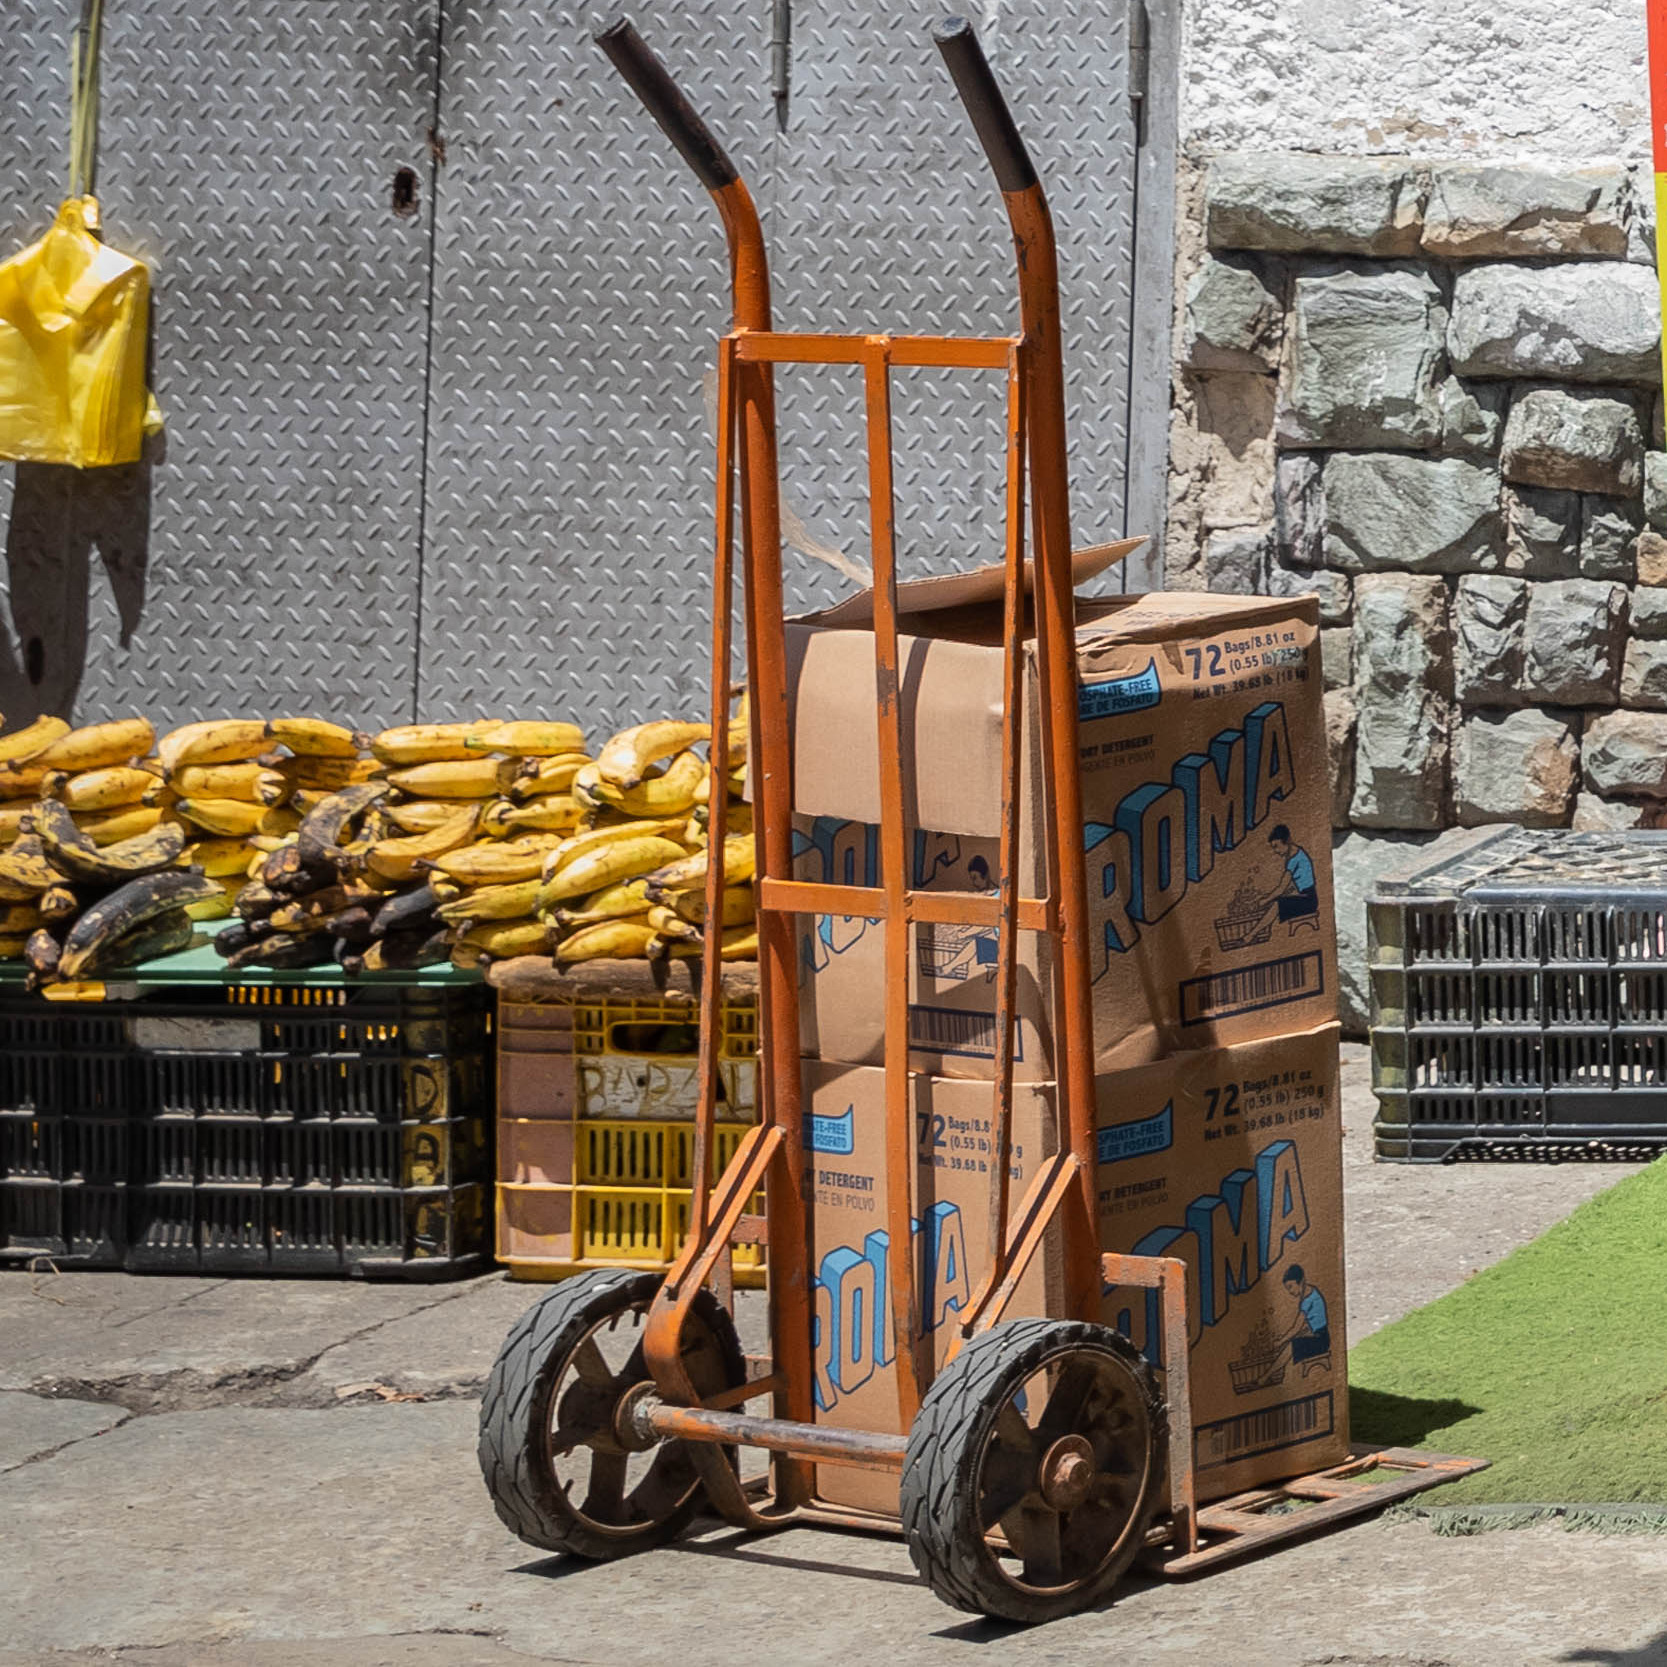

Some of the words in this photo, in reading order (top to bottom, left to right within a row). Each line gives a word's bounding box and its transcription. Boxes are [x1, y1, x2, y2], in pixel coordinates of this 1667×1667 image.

[1185, 644, 1225, 680] 72
[1224, 632, 1279, 654] Bags/8.81
[1283, 632, 1295, 643] oz
[1230, 658, 1259, 675] (0.55
[1204, 1083, 1240, 1121] 72
[819, 1170, 874, 1191] DETERGENT
[845, 1195, 875, 1212] POLVO
